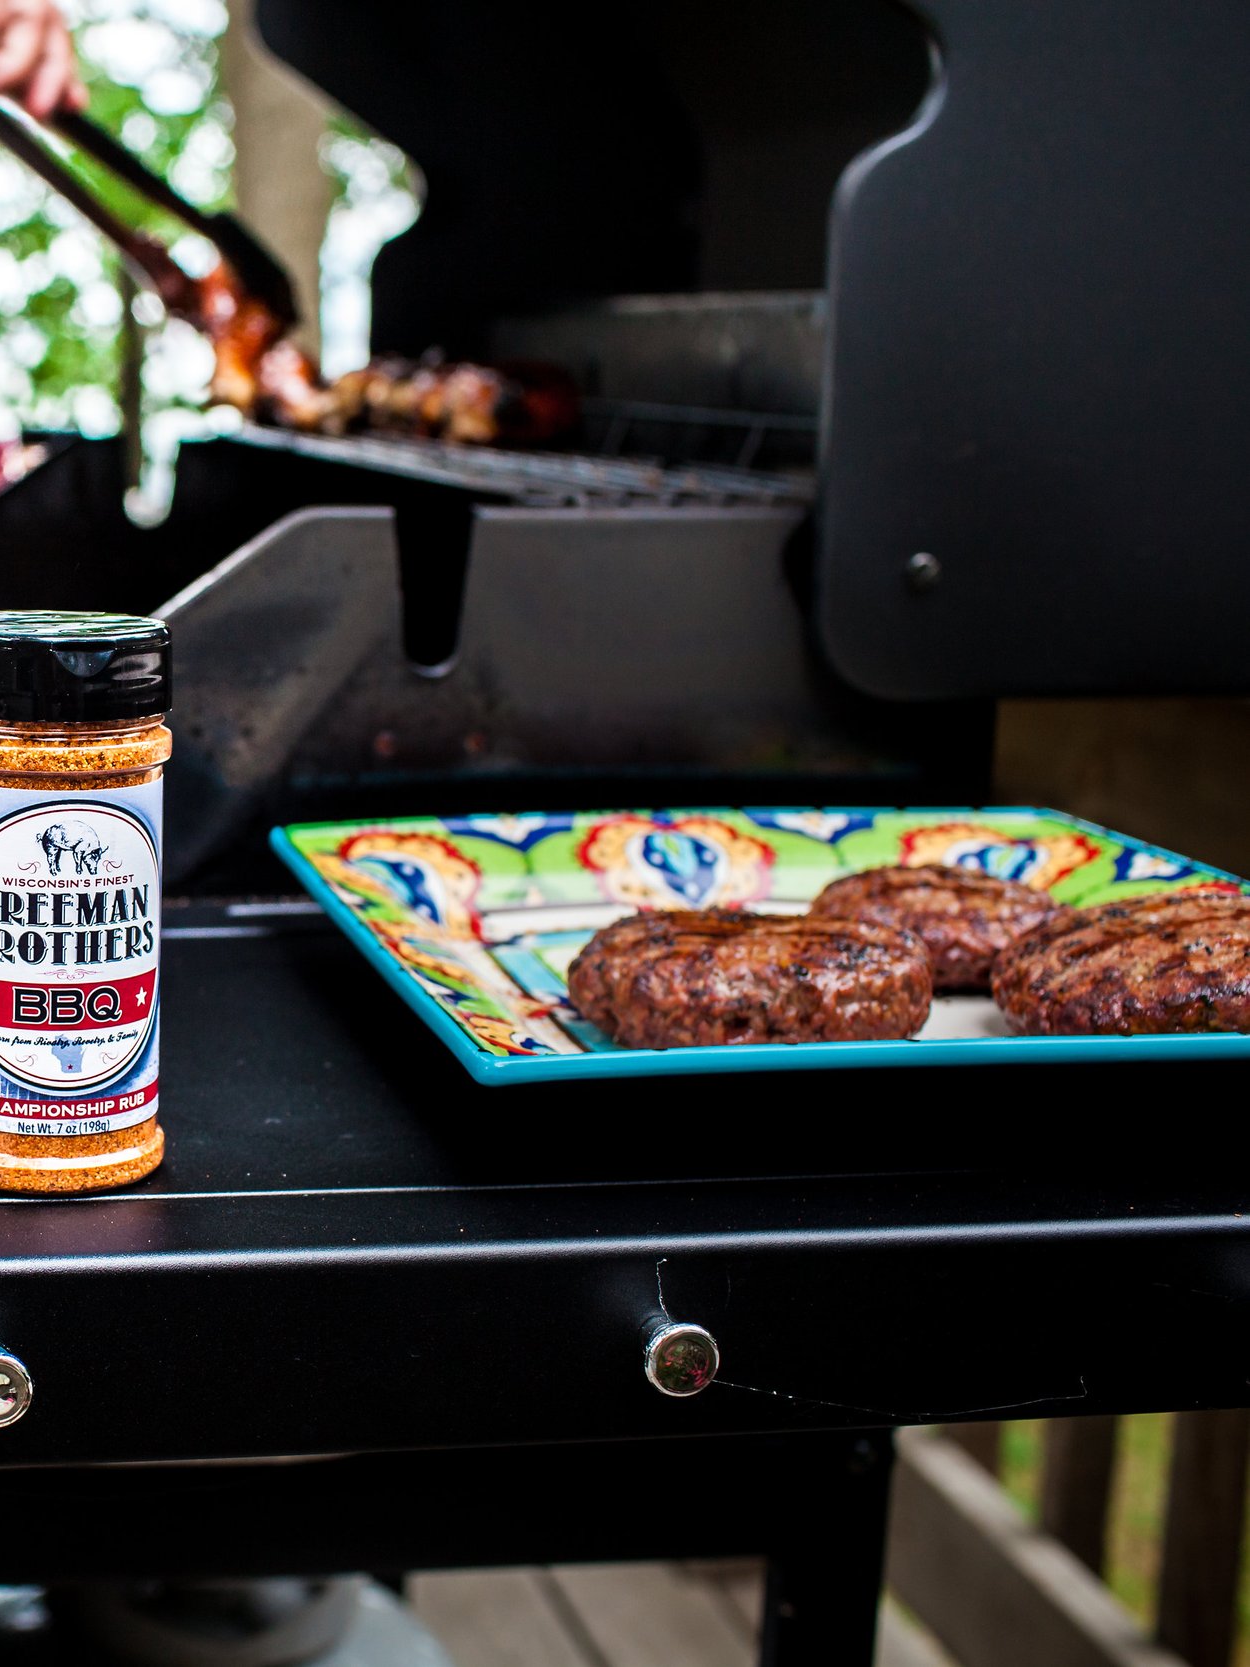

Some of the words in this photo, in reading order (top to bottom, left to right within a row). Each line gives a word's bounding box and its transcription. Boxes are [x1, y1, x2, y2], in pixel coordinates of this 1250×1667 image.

[2, 876, 91, 888] WISCONSIN'S
[95, 873, 135, 887] FINEST
[12, 985, 123, 1025] BBQ
[11, 1036, 32, 1047] from
[107, 1034, 115, 1043] &
[115, 1029, 139, 1042] Family
[119, 1092, 145, 1110] RUB
[17, 1121, 35, 1134] Net
[37, 1122, 54, 1134] Wt.
[56, 1122, 63, 1134] 7
[65, 1124, 77, 1134] oz
[78, 1119, 110, 1135] (198g)
